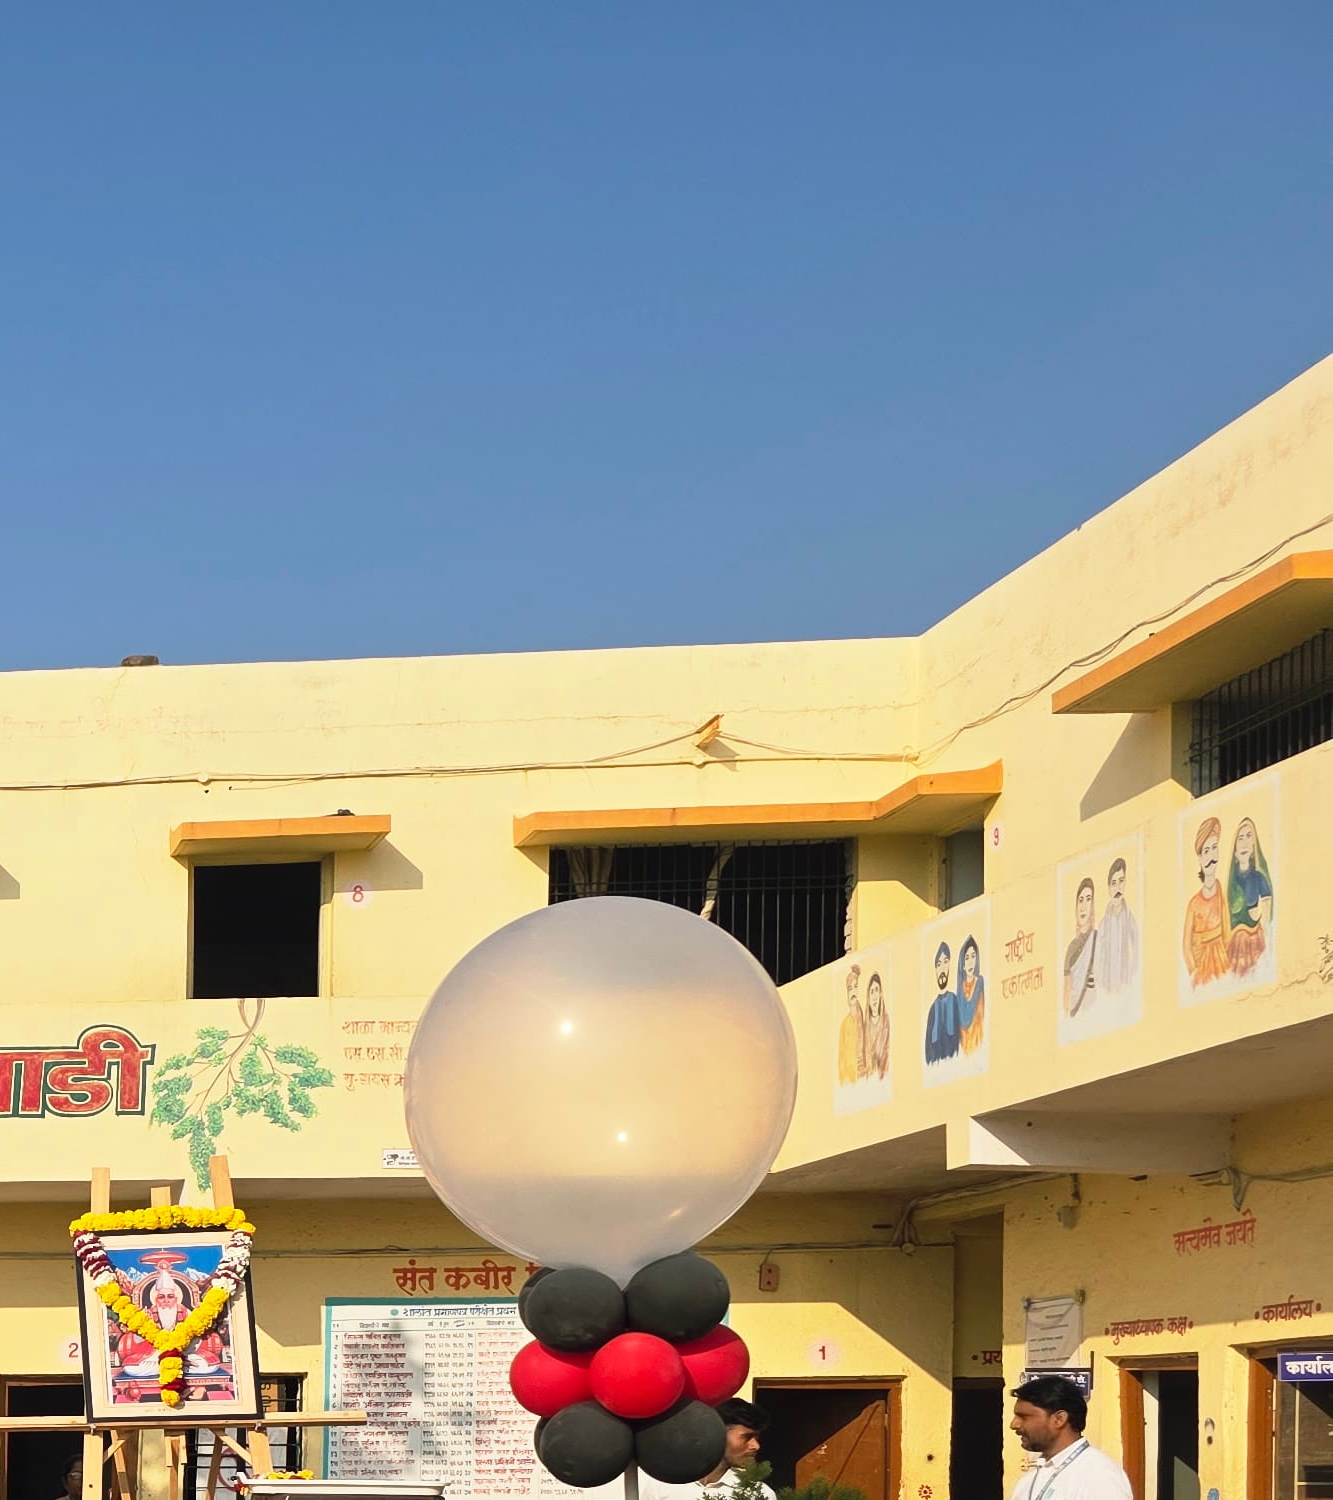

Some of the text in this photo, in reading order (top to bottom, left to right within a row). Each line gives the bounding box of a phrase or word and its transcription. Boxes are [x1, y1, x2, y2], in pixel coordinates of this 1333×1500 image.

[993, 827, 1000, 846] 9
[353, 885, 364, 902] 8
[1005, 929, 1034, 964] राष्ट्रीय
[1001, 965, 1044, 1000] एकात्मता
[1173, 1208, 1257, 1256] सत्यमेव जयते
[393, 1259, 516, 1296] संत कबीर
[1262, 1295, 1314, 1323] कार्यालय
[1167, 1315, 1188, 1337] कक्ष
[69, 1344, 78, 1358] 2
[818, 1345, 826, 1360] 1
